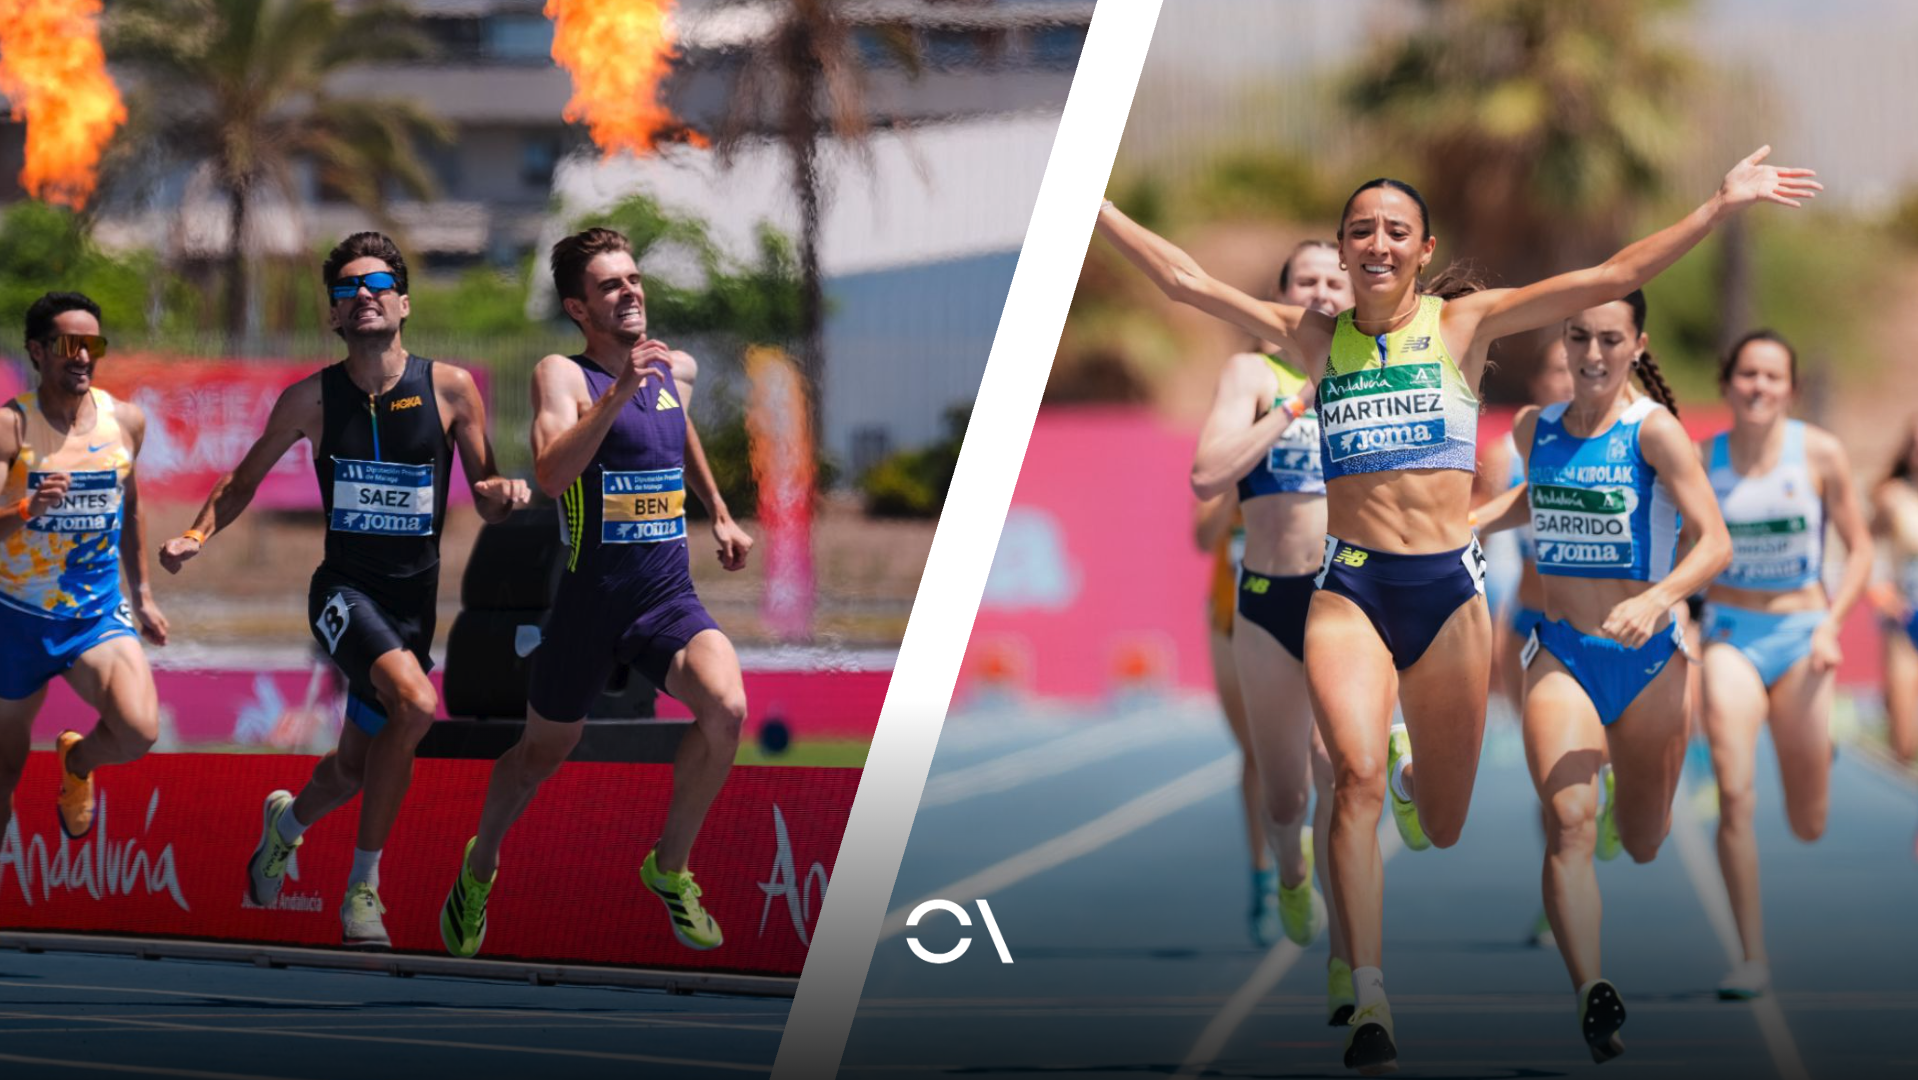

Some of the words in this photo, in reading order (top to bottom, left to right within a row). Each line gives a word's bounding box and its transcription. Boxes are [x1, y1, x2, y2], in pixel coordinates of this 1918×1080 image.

[1327, 373, 1393, 396] Andalucía
[391, 395, 422, 410] HOKA
[1323, 393, 1444, 428] MARTINEZ
[1356, 424, 1432, 450] Joma
[1577, 465, 1634, 484] KIROLAK
[50, 494, 107, 509] ONTES
[359, 488, 411, 508] SAEZ
[635, 498, 668, 515] BEN
[53, 515, 107, 531] Joma
[360, 513, 421, 531] Joma
[633, 521, 677, 539] Joma
[1534, 514, 1623, 535] GARRIDO
[1552, 542, 1620, 563] Joma
[324, 604, 344, 641] 8
[0, 786, 190, 912] Andalucía
